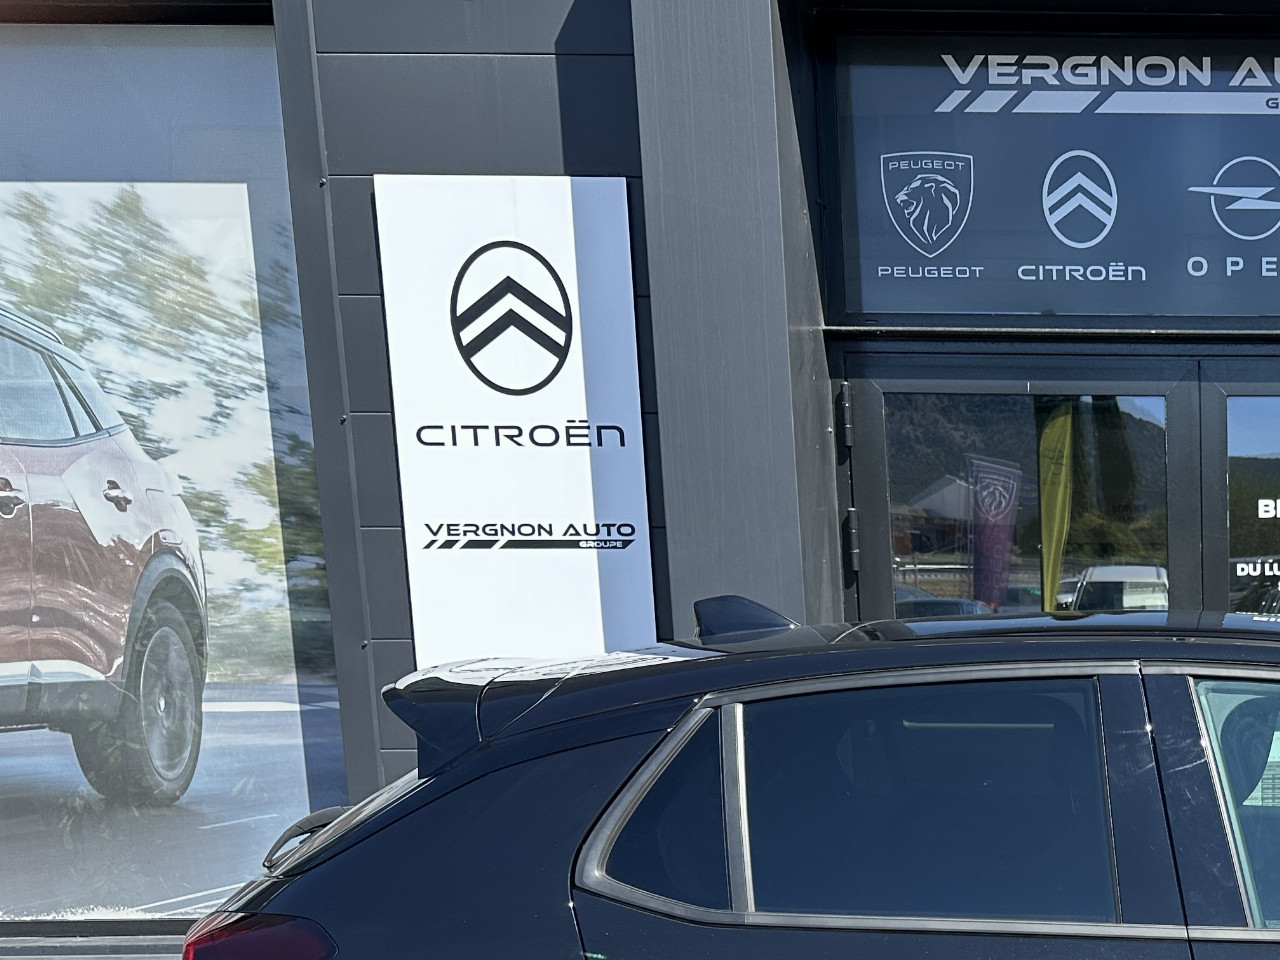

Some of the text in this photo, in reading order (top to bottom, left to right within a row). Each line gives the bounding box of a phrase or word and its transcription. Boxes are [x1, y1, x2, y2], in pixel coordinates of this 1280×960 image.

[941, 54, 1213, 87] VERGNON
[888, 160, 965, 171] PEUGEOT
[878, 266, 984, 278] PEUGEOT
[424, 523, 637, 537] VERGNON AUTO
[579, 540, 623, 549] GROUPE
[1236, 562, 1261, 577] DU
